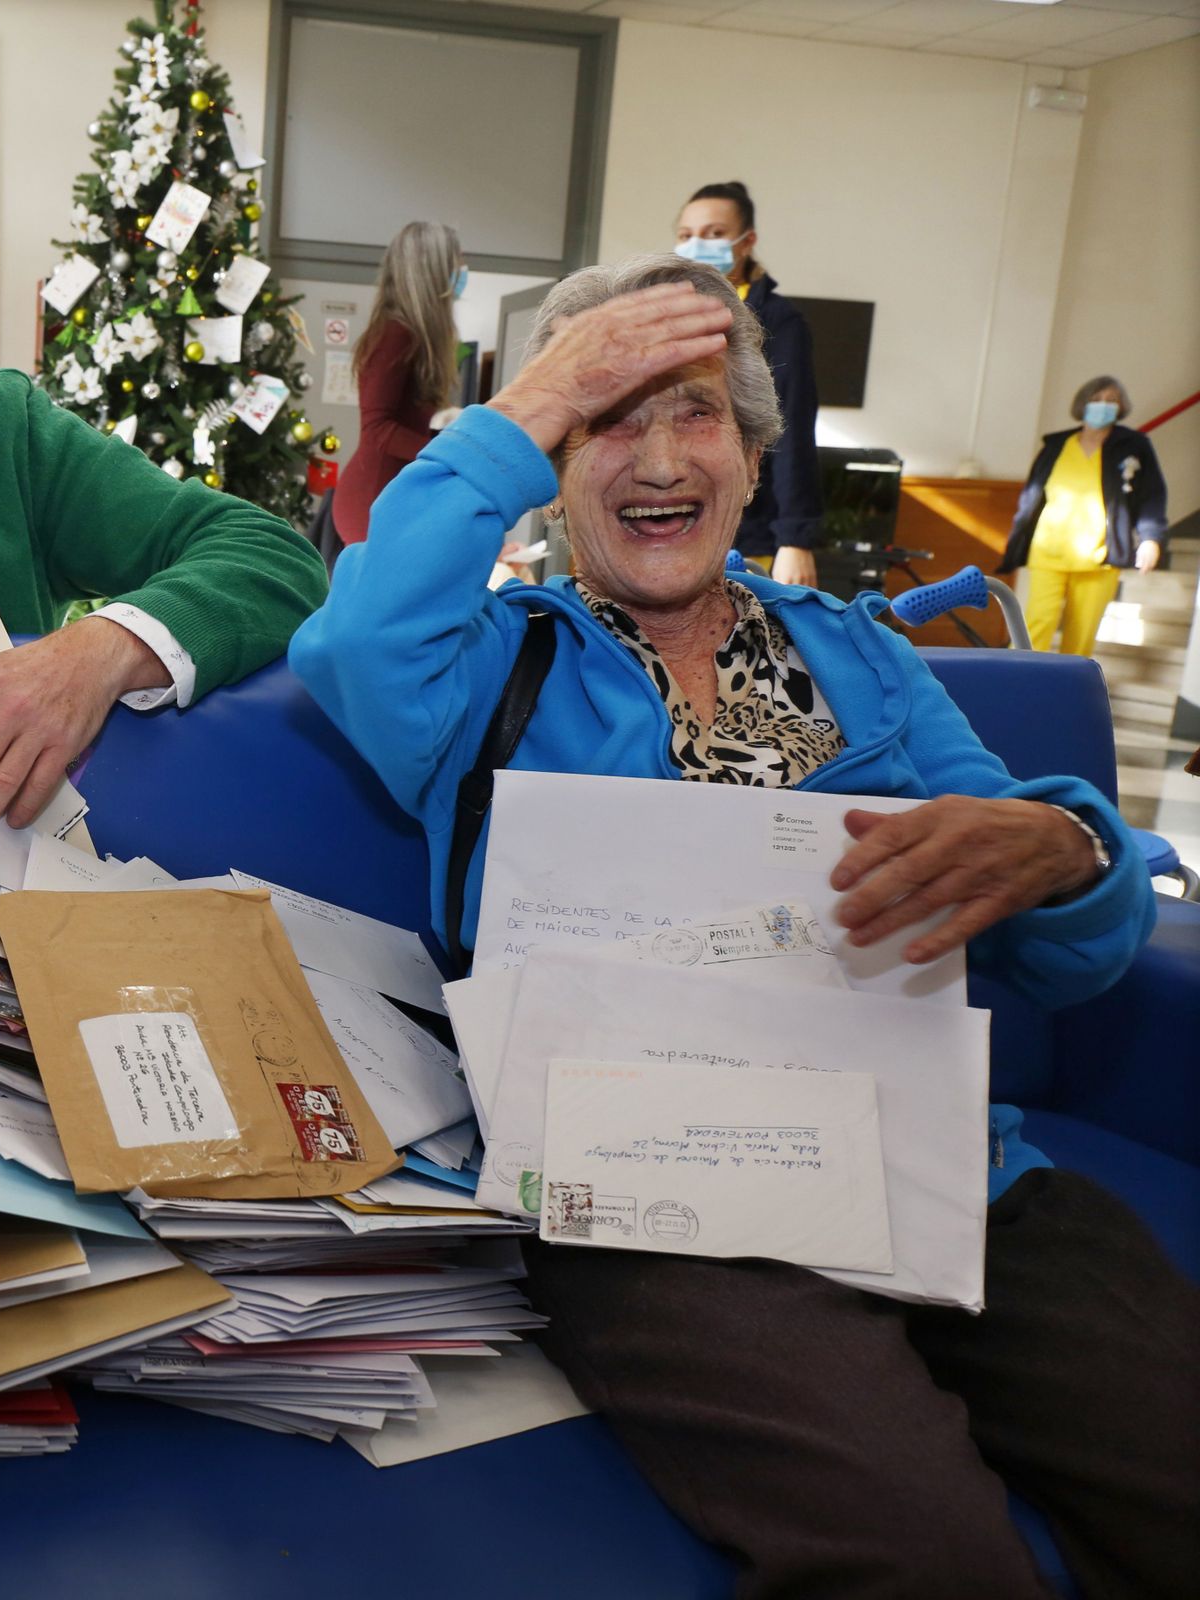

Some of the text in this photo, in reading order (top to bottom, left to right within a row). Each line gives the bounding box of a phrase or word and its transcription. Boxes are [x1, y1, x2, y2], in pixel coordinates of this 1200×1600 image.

[785, 816, 813, 826] Correos
[506, 917, 526, 931] DE
[624, 911, 645, 924] DE
[654, 916, 673, 927] LA
[709, 928, 746, 942] POSTAL
[162, 1023, 183, 1068] Residencia
[114, 1043, 148, 1127] 36003 Pontevedra
[308, 1093, 327, 1112] 75
[165, 1100, 181, 1133] MORENO
[324, 1131, 343, 1150] 75
[685, 1128, 819, 1141] 36003 PONTEVEDRA
[632, 1139, 649, 1149] 26
[653, 1153, 669, 1165] de
[730, 1156, 745, 1168] de
[754, 1158, 822, 1170] Residencia
